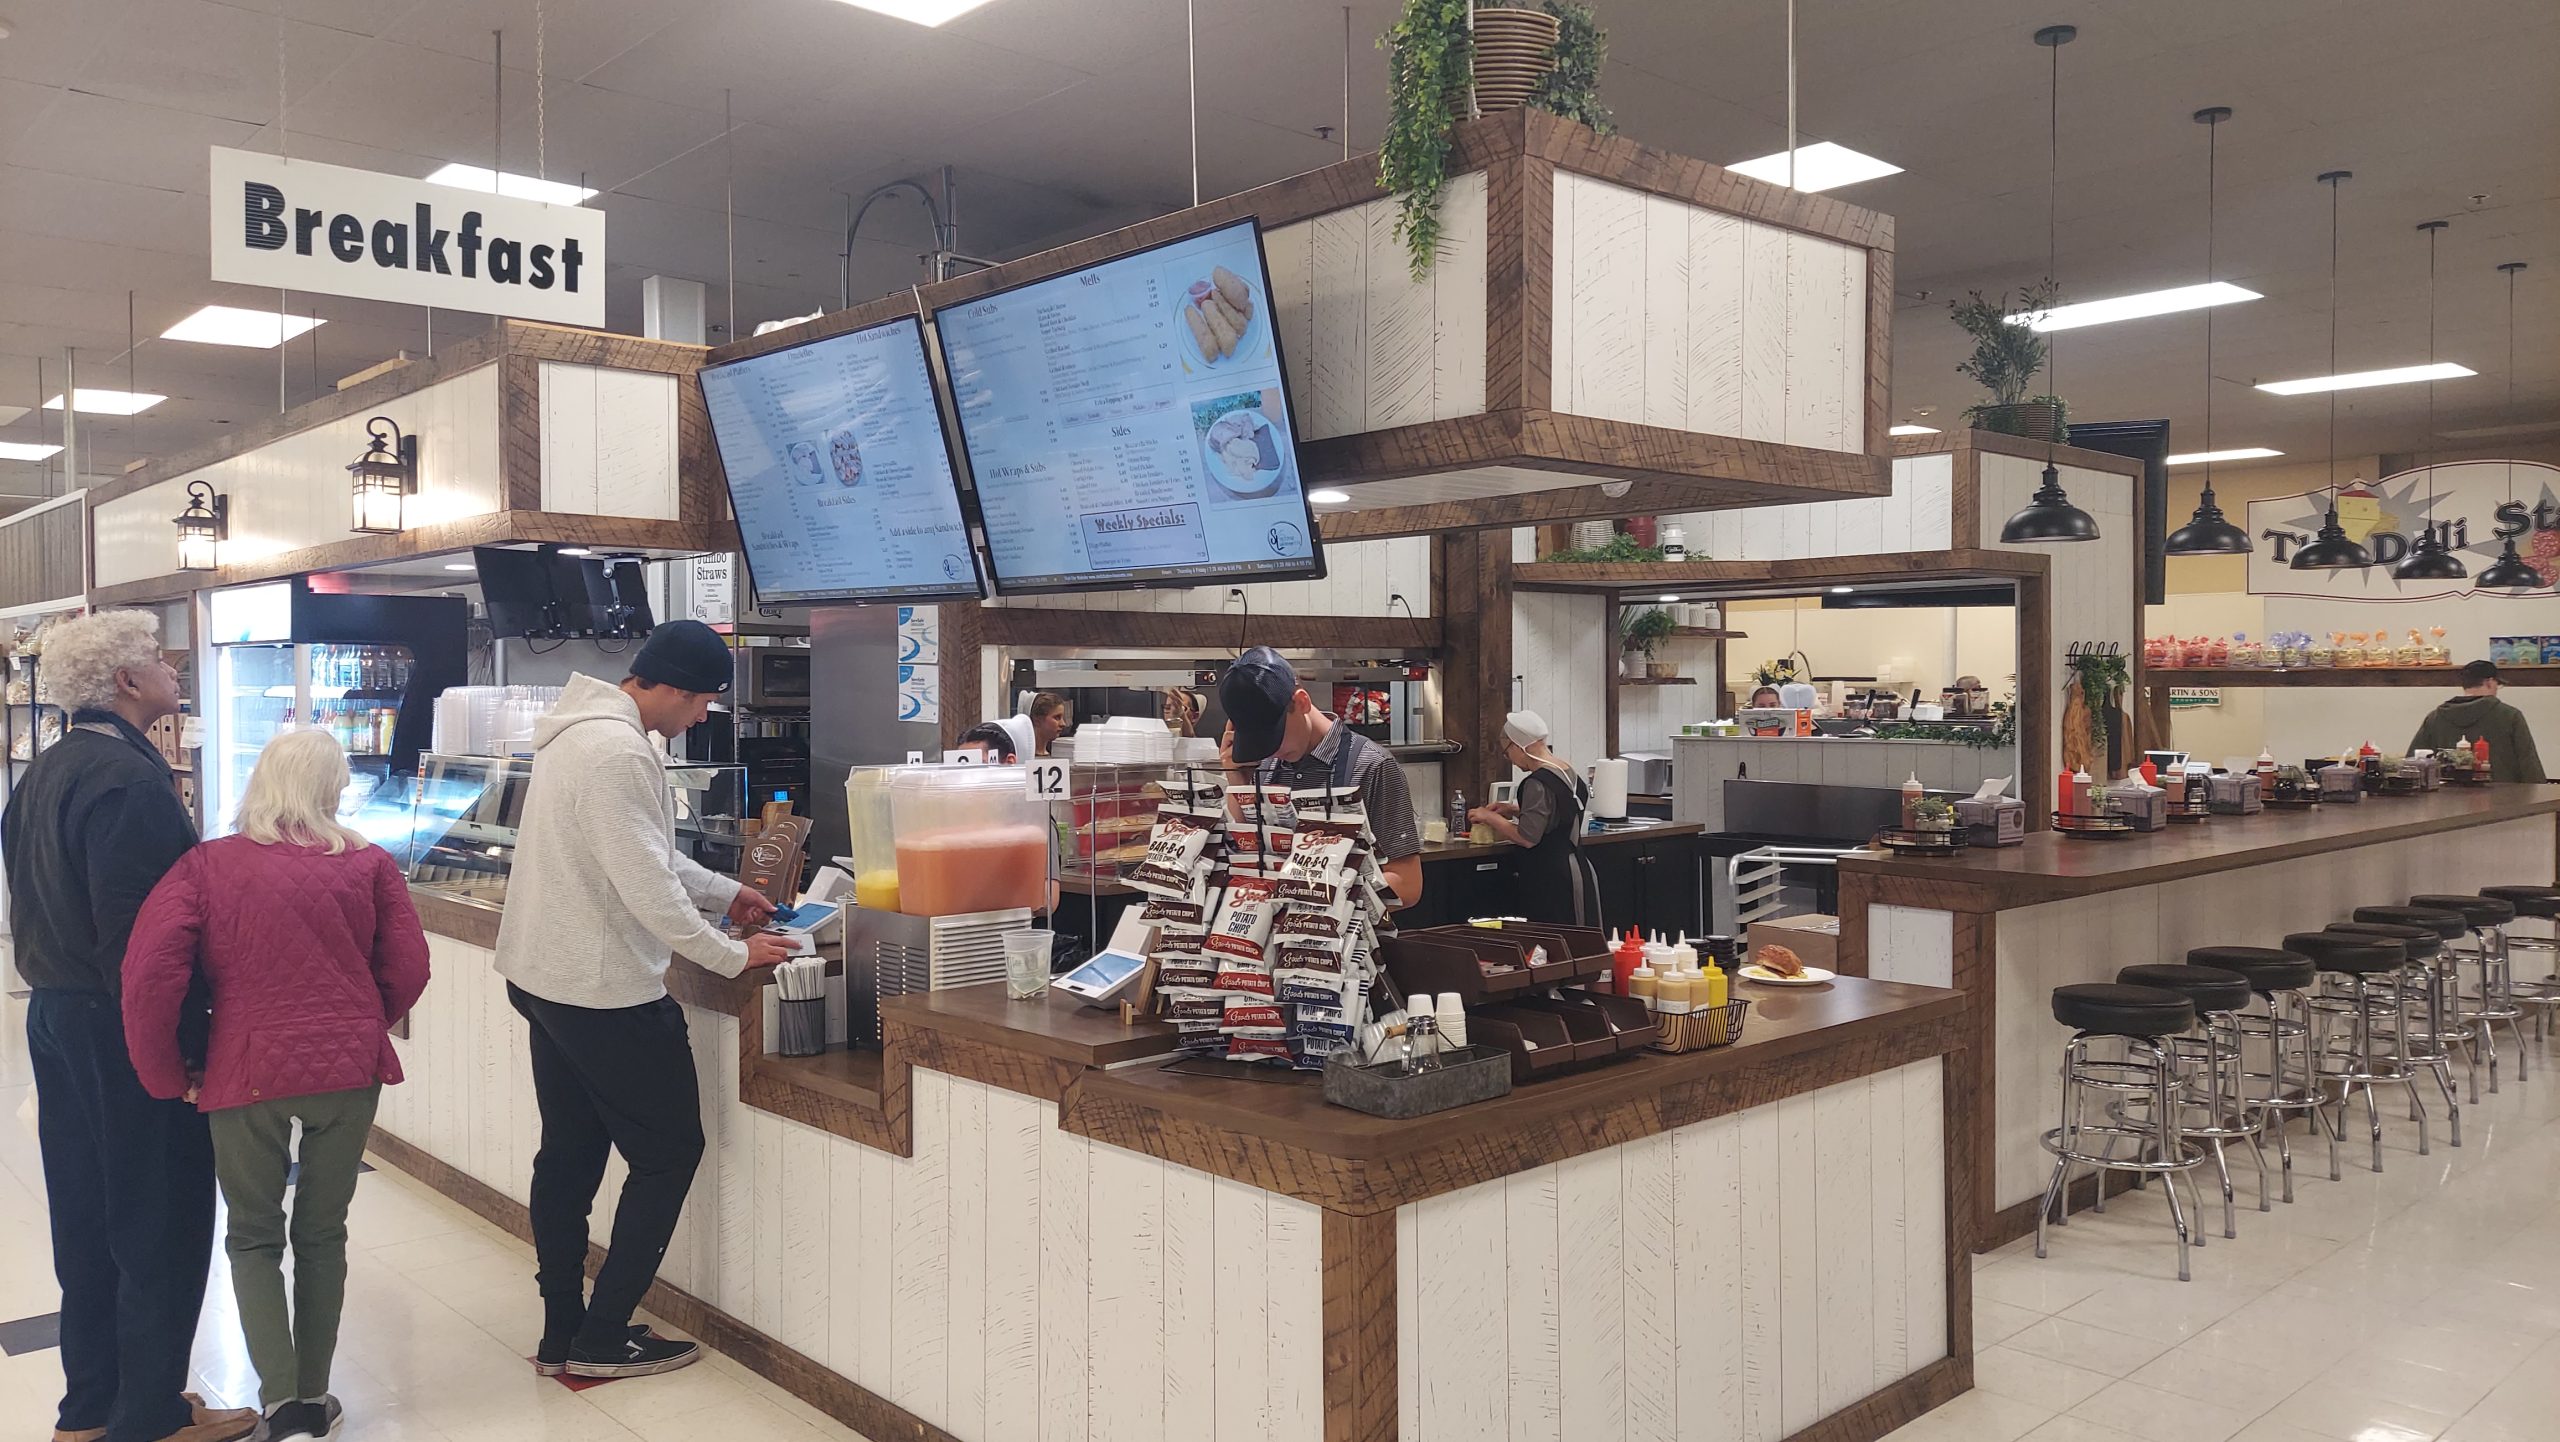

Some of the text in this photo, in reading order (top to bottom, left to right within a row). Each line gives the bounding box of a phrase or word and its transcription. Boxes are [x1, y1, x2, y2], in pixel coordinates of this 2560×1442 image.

[245, 181, 582, 292] Breakfast
[982, 303, 998, 317] Subs
[1112, 425, 1131, 437] Sides
[1001, 466, 1024, 478] Wraps
[1025, 465, 1029, 473] &
[1030, 462, 1046, 473] Subs
[1095, 508, 1185, 532] Weekly Specials:
[697, 566, 727, 580] Straws
[1033, 766, 1063, 794] 12
[1152, 872, 1166, 880] POTATO
[1166, 874, 1179, 883] CHIPS
[1313, 890, 1325, 898] CHIPS
[1230, 911, 1257, 924] POTATO
[1228, 922, 1251, 935] CHIPS
[1319, 923, 1331, 931] CHIPS
[1320, 958, 1333, 966] CHIPS
[1257, 980, 1270, 988] CHIPS
